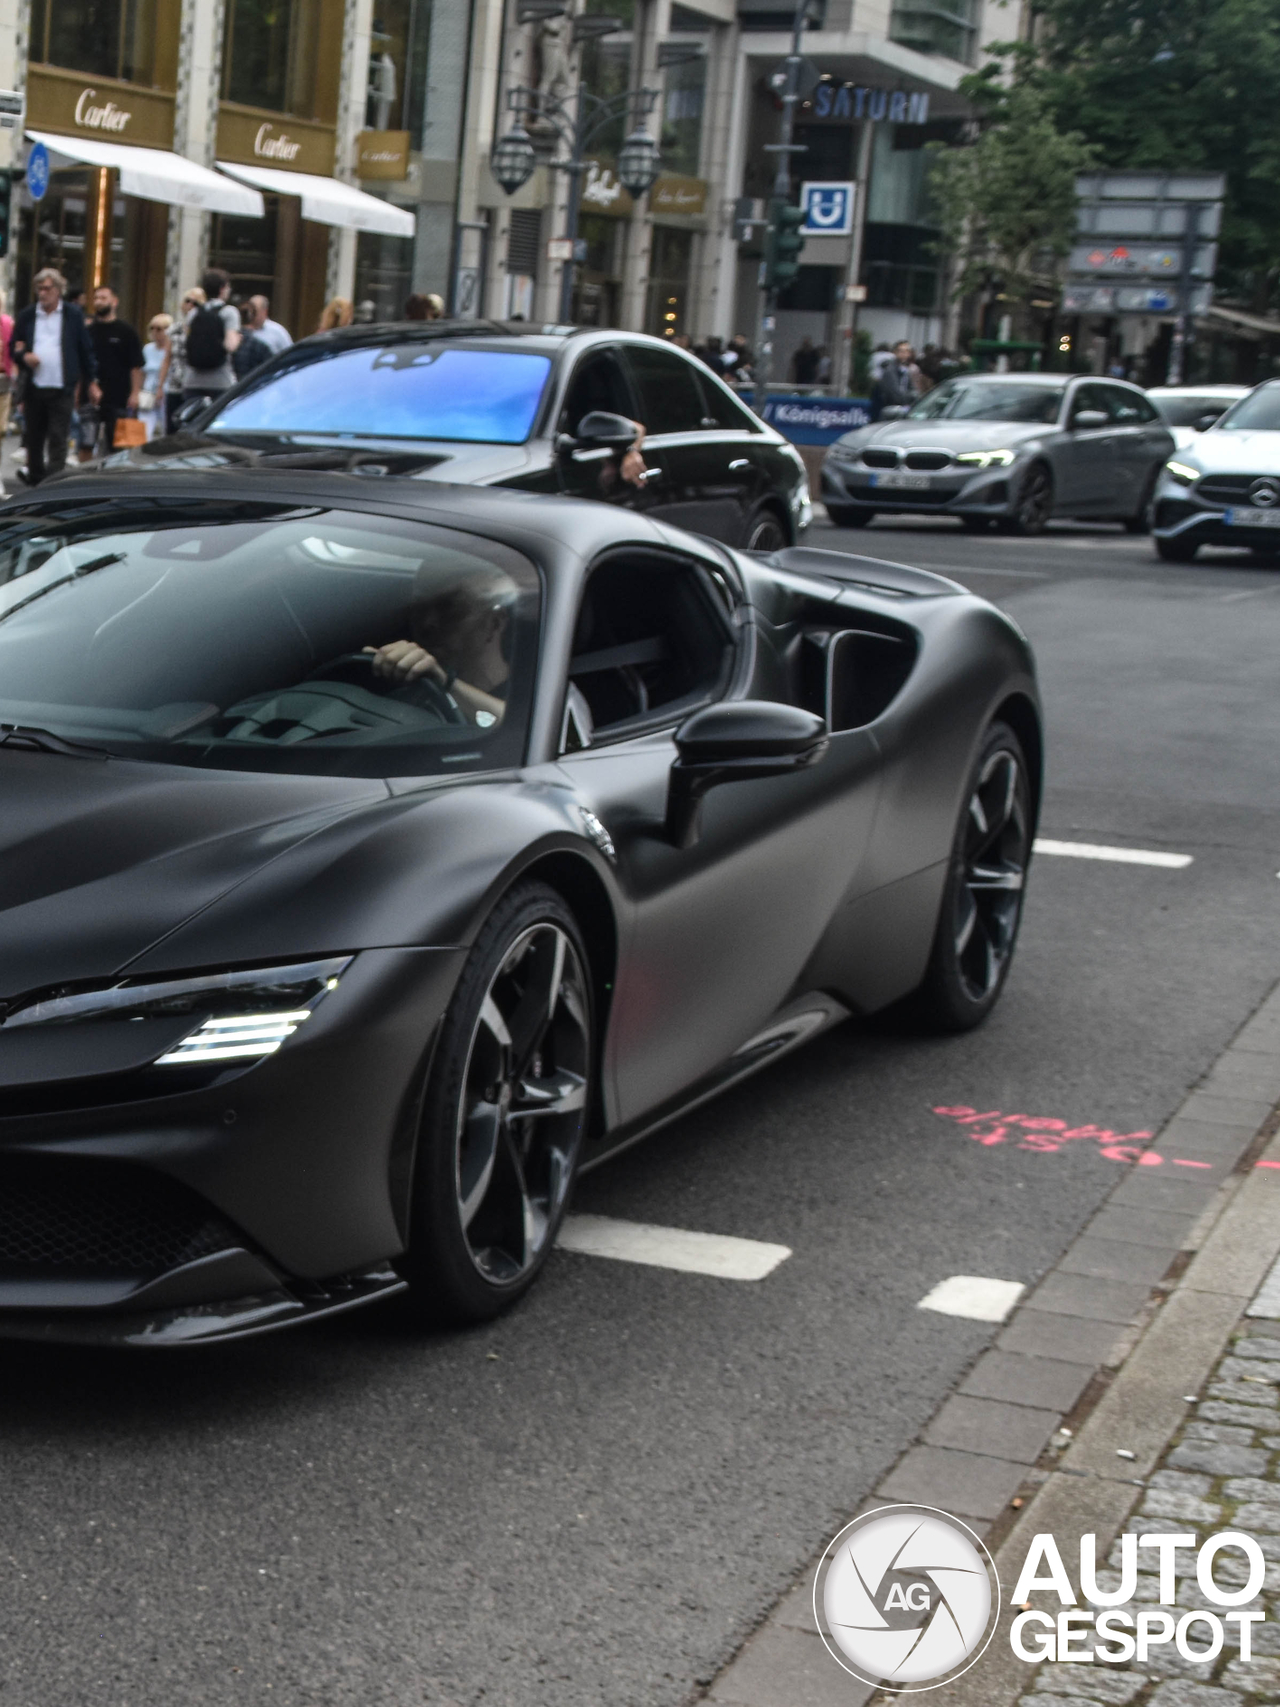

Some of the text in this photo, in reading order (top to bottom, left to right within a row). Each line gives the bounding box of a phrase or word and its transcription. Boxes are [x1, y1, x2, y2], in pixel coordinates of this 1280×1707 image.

[74, 87, 132, 132] Cartier
[815, 84, 930, 125] SATURN
[254, 122, 301, 161] Cartier
